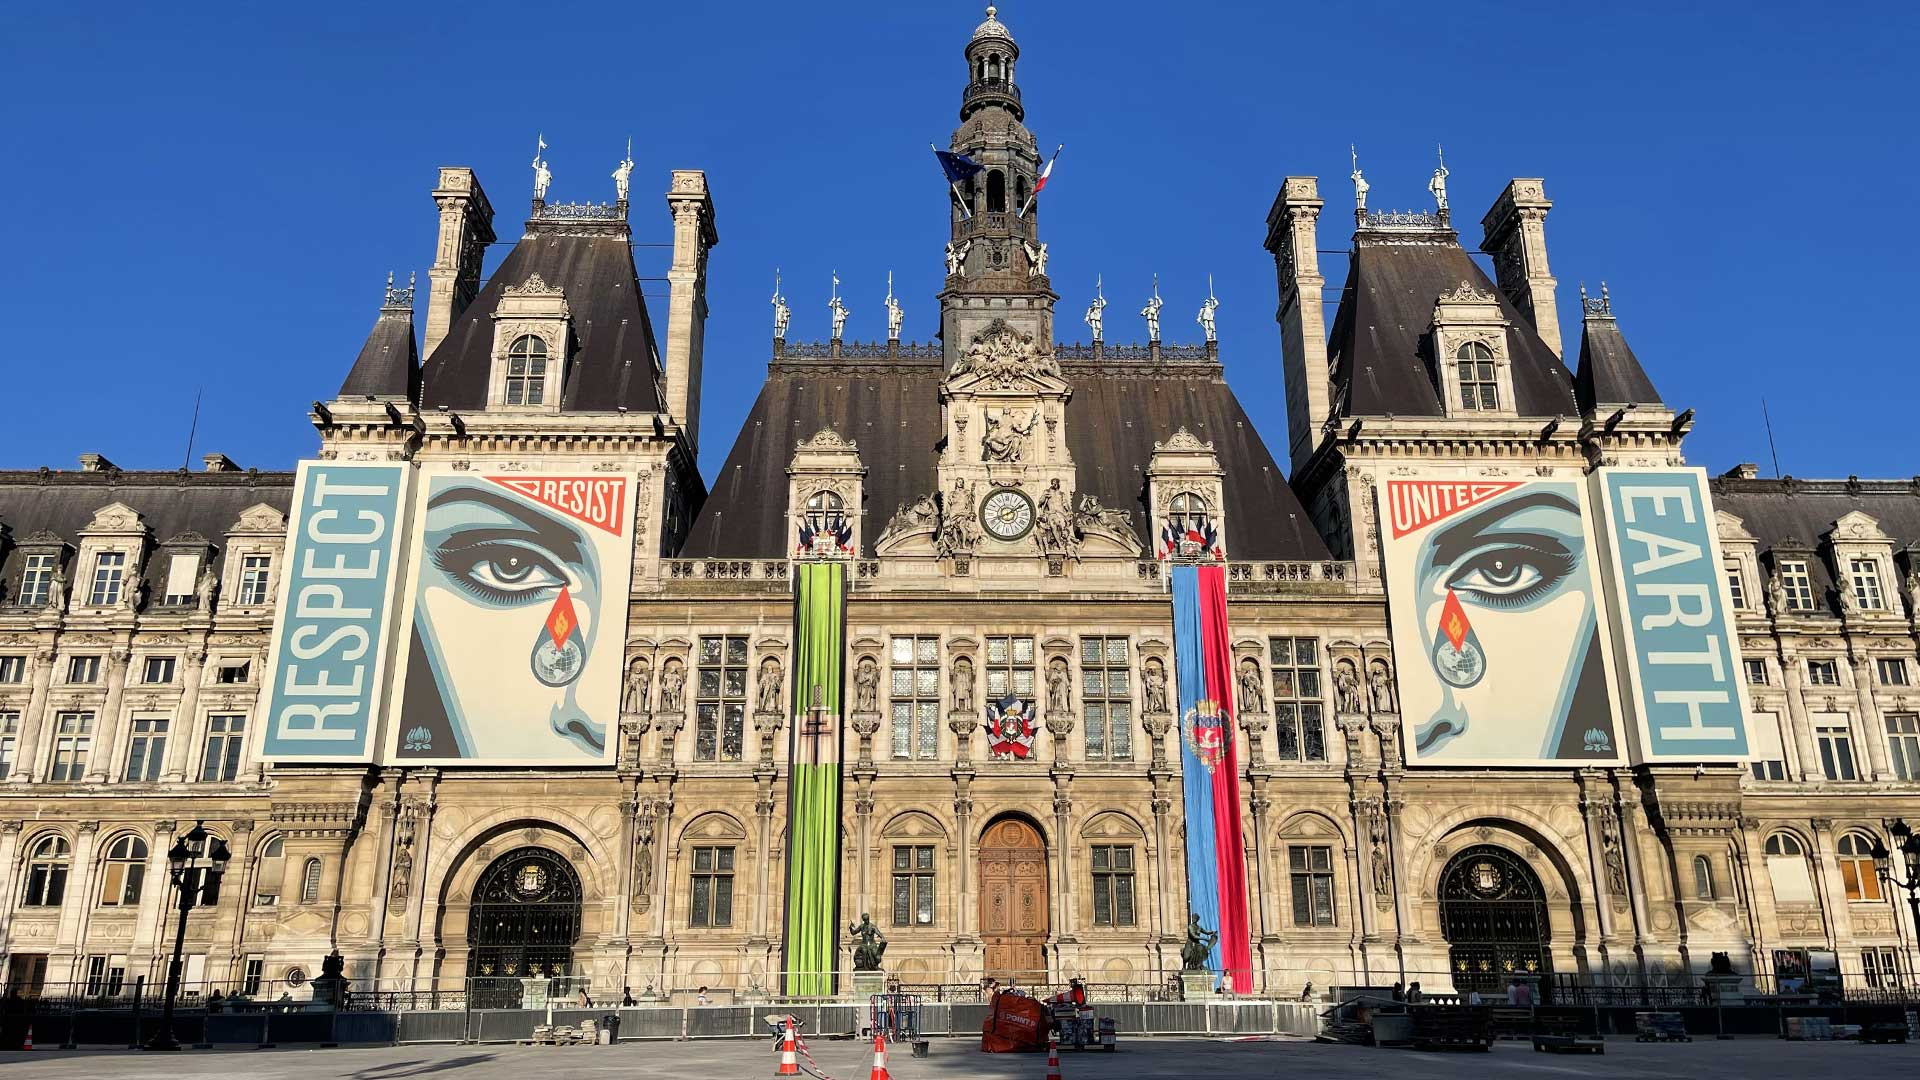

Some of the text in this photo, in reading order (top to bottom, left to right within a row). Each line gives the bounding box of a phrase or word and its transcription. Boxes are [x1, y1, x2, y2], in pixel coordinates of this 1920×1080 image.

[543, 480, 624, 528] RESIST
[1392, 484, 1470, 531] UNITE
[277, 473, 389, 741] RESPECT
[1619, 486, 1736, 741] EARTH
